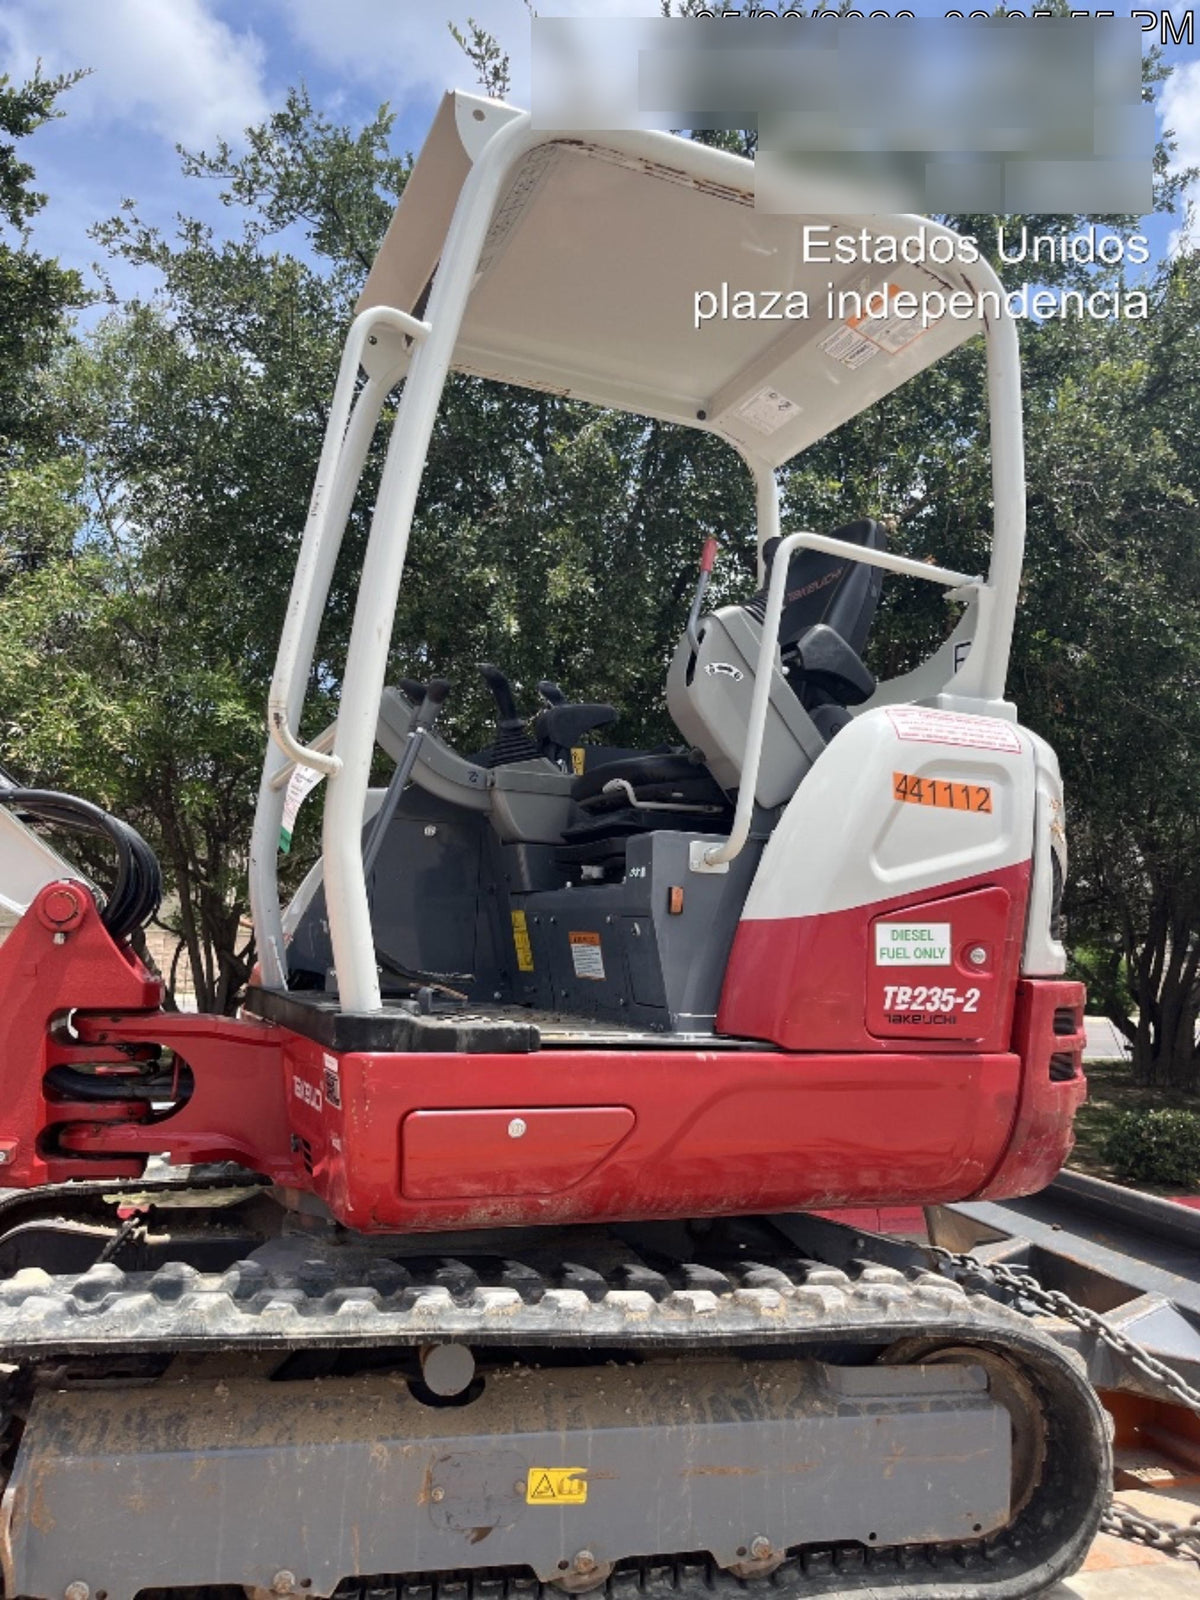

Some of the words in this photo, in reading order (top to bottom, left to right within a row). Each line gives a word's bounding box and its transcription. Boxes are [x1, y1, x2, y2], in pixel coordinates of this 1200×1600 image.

[895, 774, 991, 814] 441112
[891, 929, 934, 941] DIESEL
[880, 946, 911, 959] FUEL
[913, 946, 946, 959] ONLY
[883, 986, 981, 1013] TB235-2
